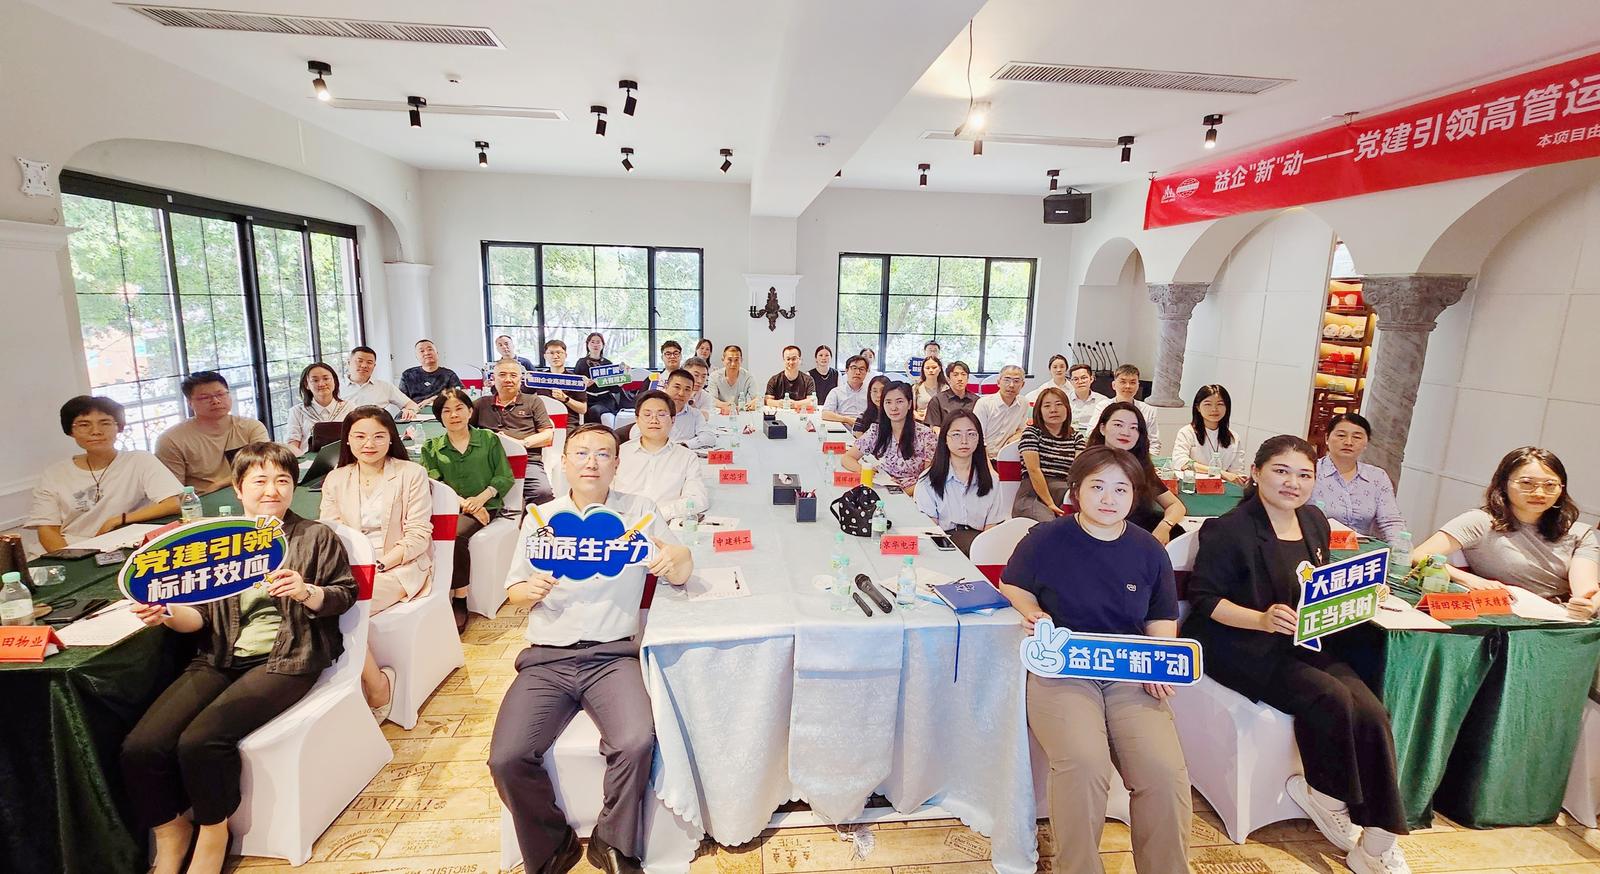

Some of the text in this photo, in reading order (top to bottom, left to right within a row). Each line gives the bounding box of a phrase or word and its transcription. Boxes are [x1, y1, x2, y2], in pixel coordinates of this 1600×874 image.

[1537, 123, 1600, 148] 本项目由
[133, 526, 273, 579] 党建引领
[525, 536, 655, 563] 新质生产力
[716, 536, 751, 547] 中建科工
[883, 540, 917, 550] 京华电子
[147, 553, 270, 602] 标杆效应
[1311, 557, 1382, 599] 大显身手
[1303, 592, 1375, 636] 正当其时
[1430, 600, 1472, 611] 福田保安
